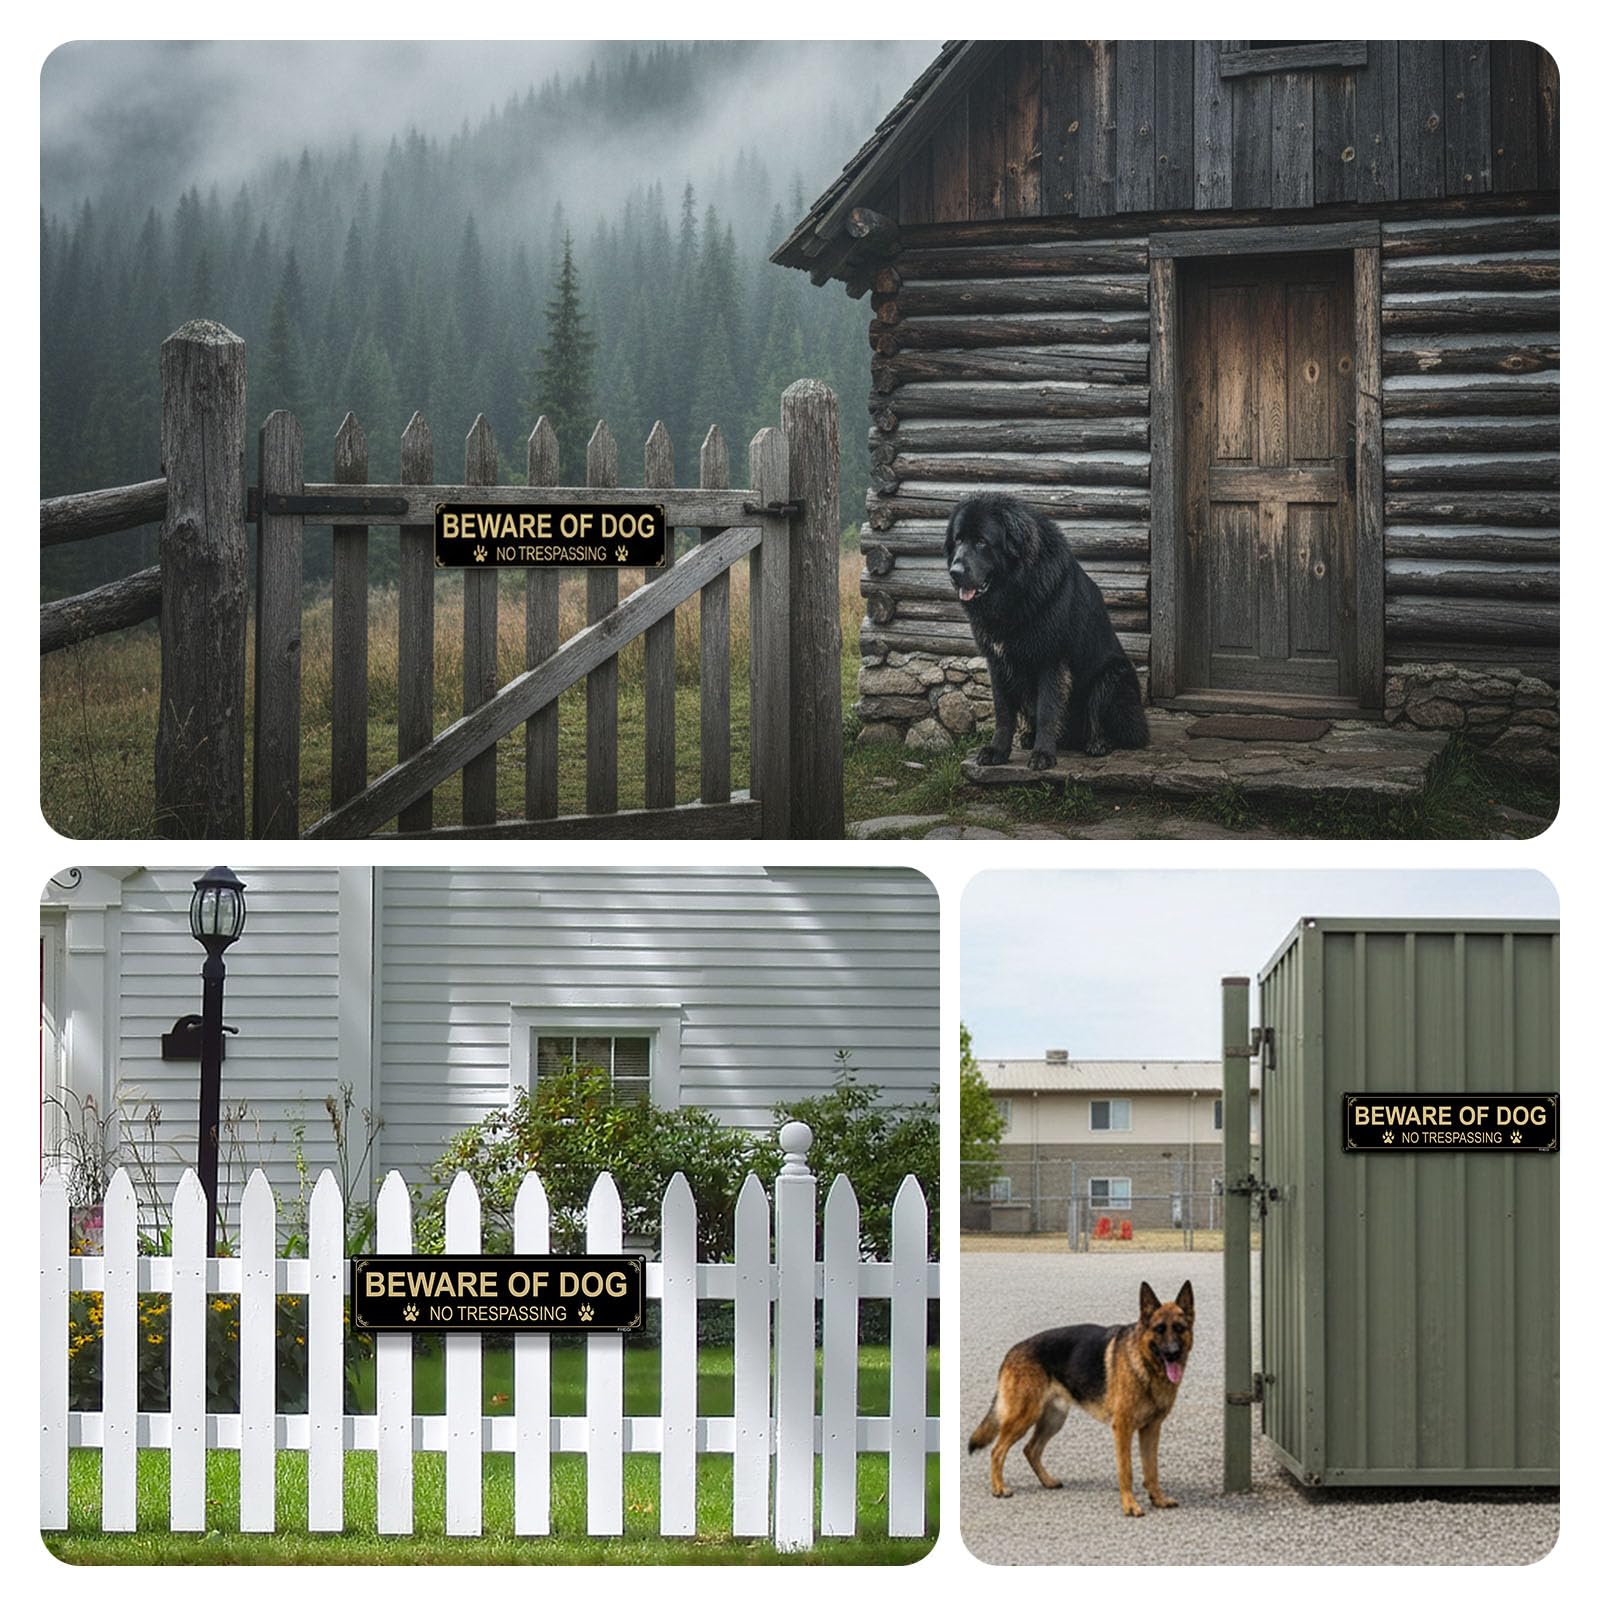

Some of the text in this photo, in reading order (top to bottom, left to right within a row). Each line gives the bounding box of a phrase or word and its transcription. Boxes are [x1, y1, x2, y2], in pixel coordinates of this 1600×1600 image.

[443, 513, 655, 538] BEWARE OF DOG
[496, 546, 607, 561] NO TRESPASSING
[1355, 1106, 1547, 1126] BEWARE OF DOG
[1402, 1132, 1502, 1144] NO TRESPASSING
[366, 1271, 627, 1298] BEWARE OF DOG
[430, 1306, 567, 1321] NO TRESPASSING
